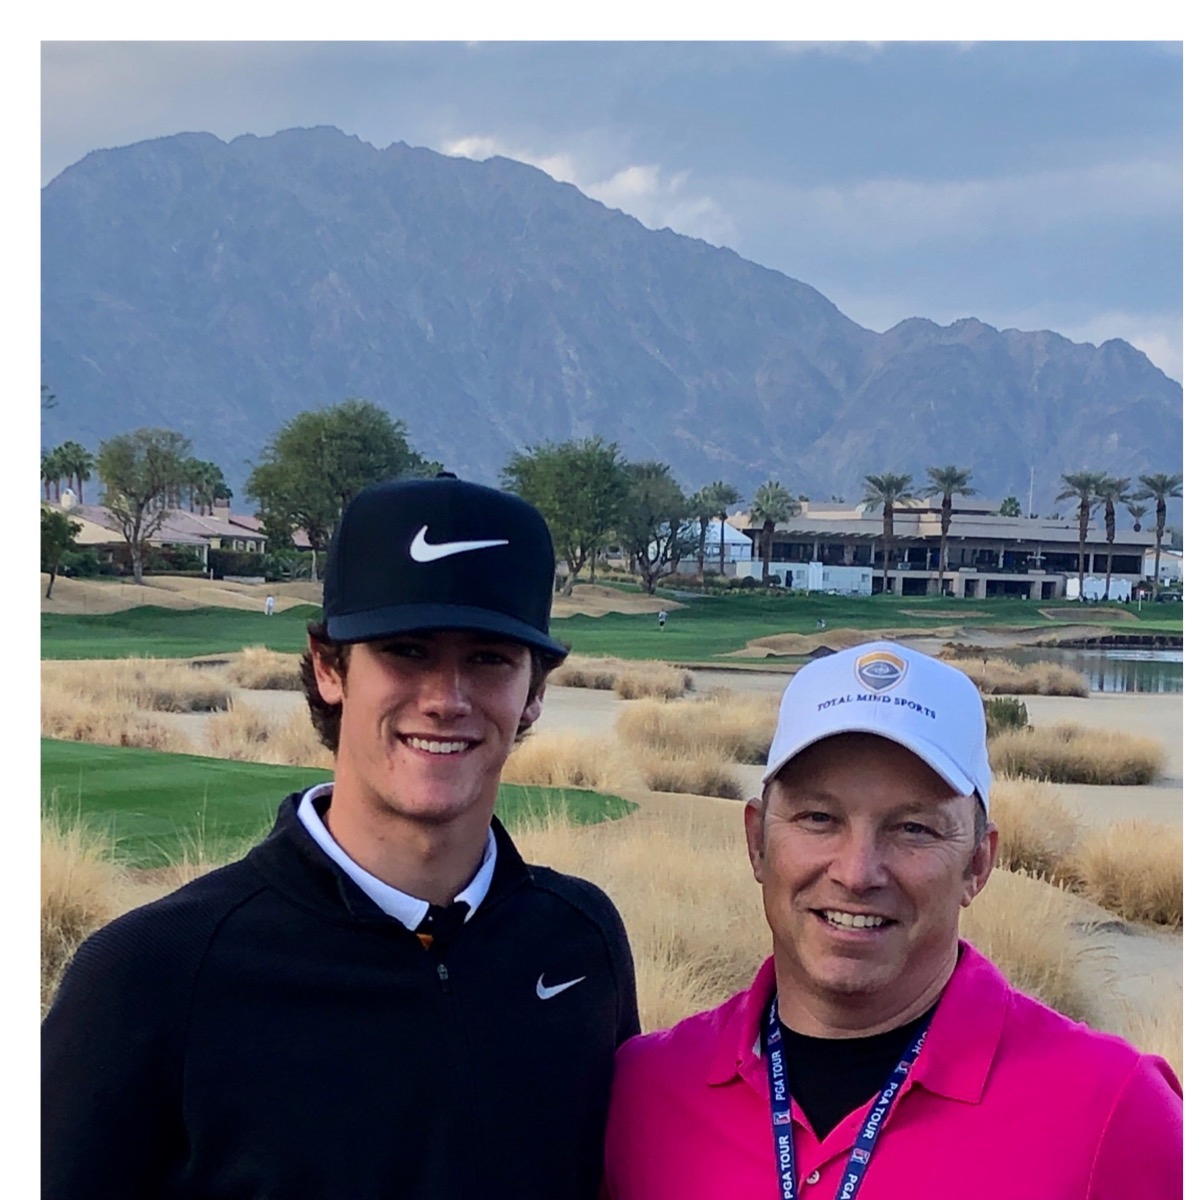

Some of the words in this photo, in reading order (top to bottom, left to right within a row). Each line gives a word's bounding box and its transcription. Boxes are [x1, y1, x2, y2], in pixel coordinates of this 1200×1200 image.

[817, 694, 853, 711] TOTAL
[856, 693, 891, 704] MIND
[893, 697, 936, 720] SPORTS
[771, 1049, 783, 1078] TOUR
[774, 1078, 786, 1101] PGA
[878, 1082, 898, 1106] PGA
[863, 1107, 886, 1140] TOUR
[778, 1135, 791, 1171] TOUR
[782, 1171, 793, 1200] PGA
[840, 1174, 858, 1200] PGA
